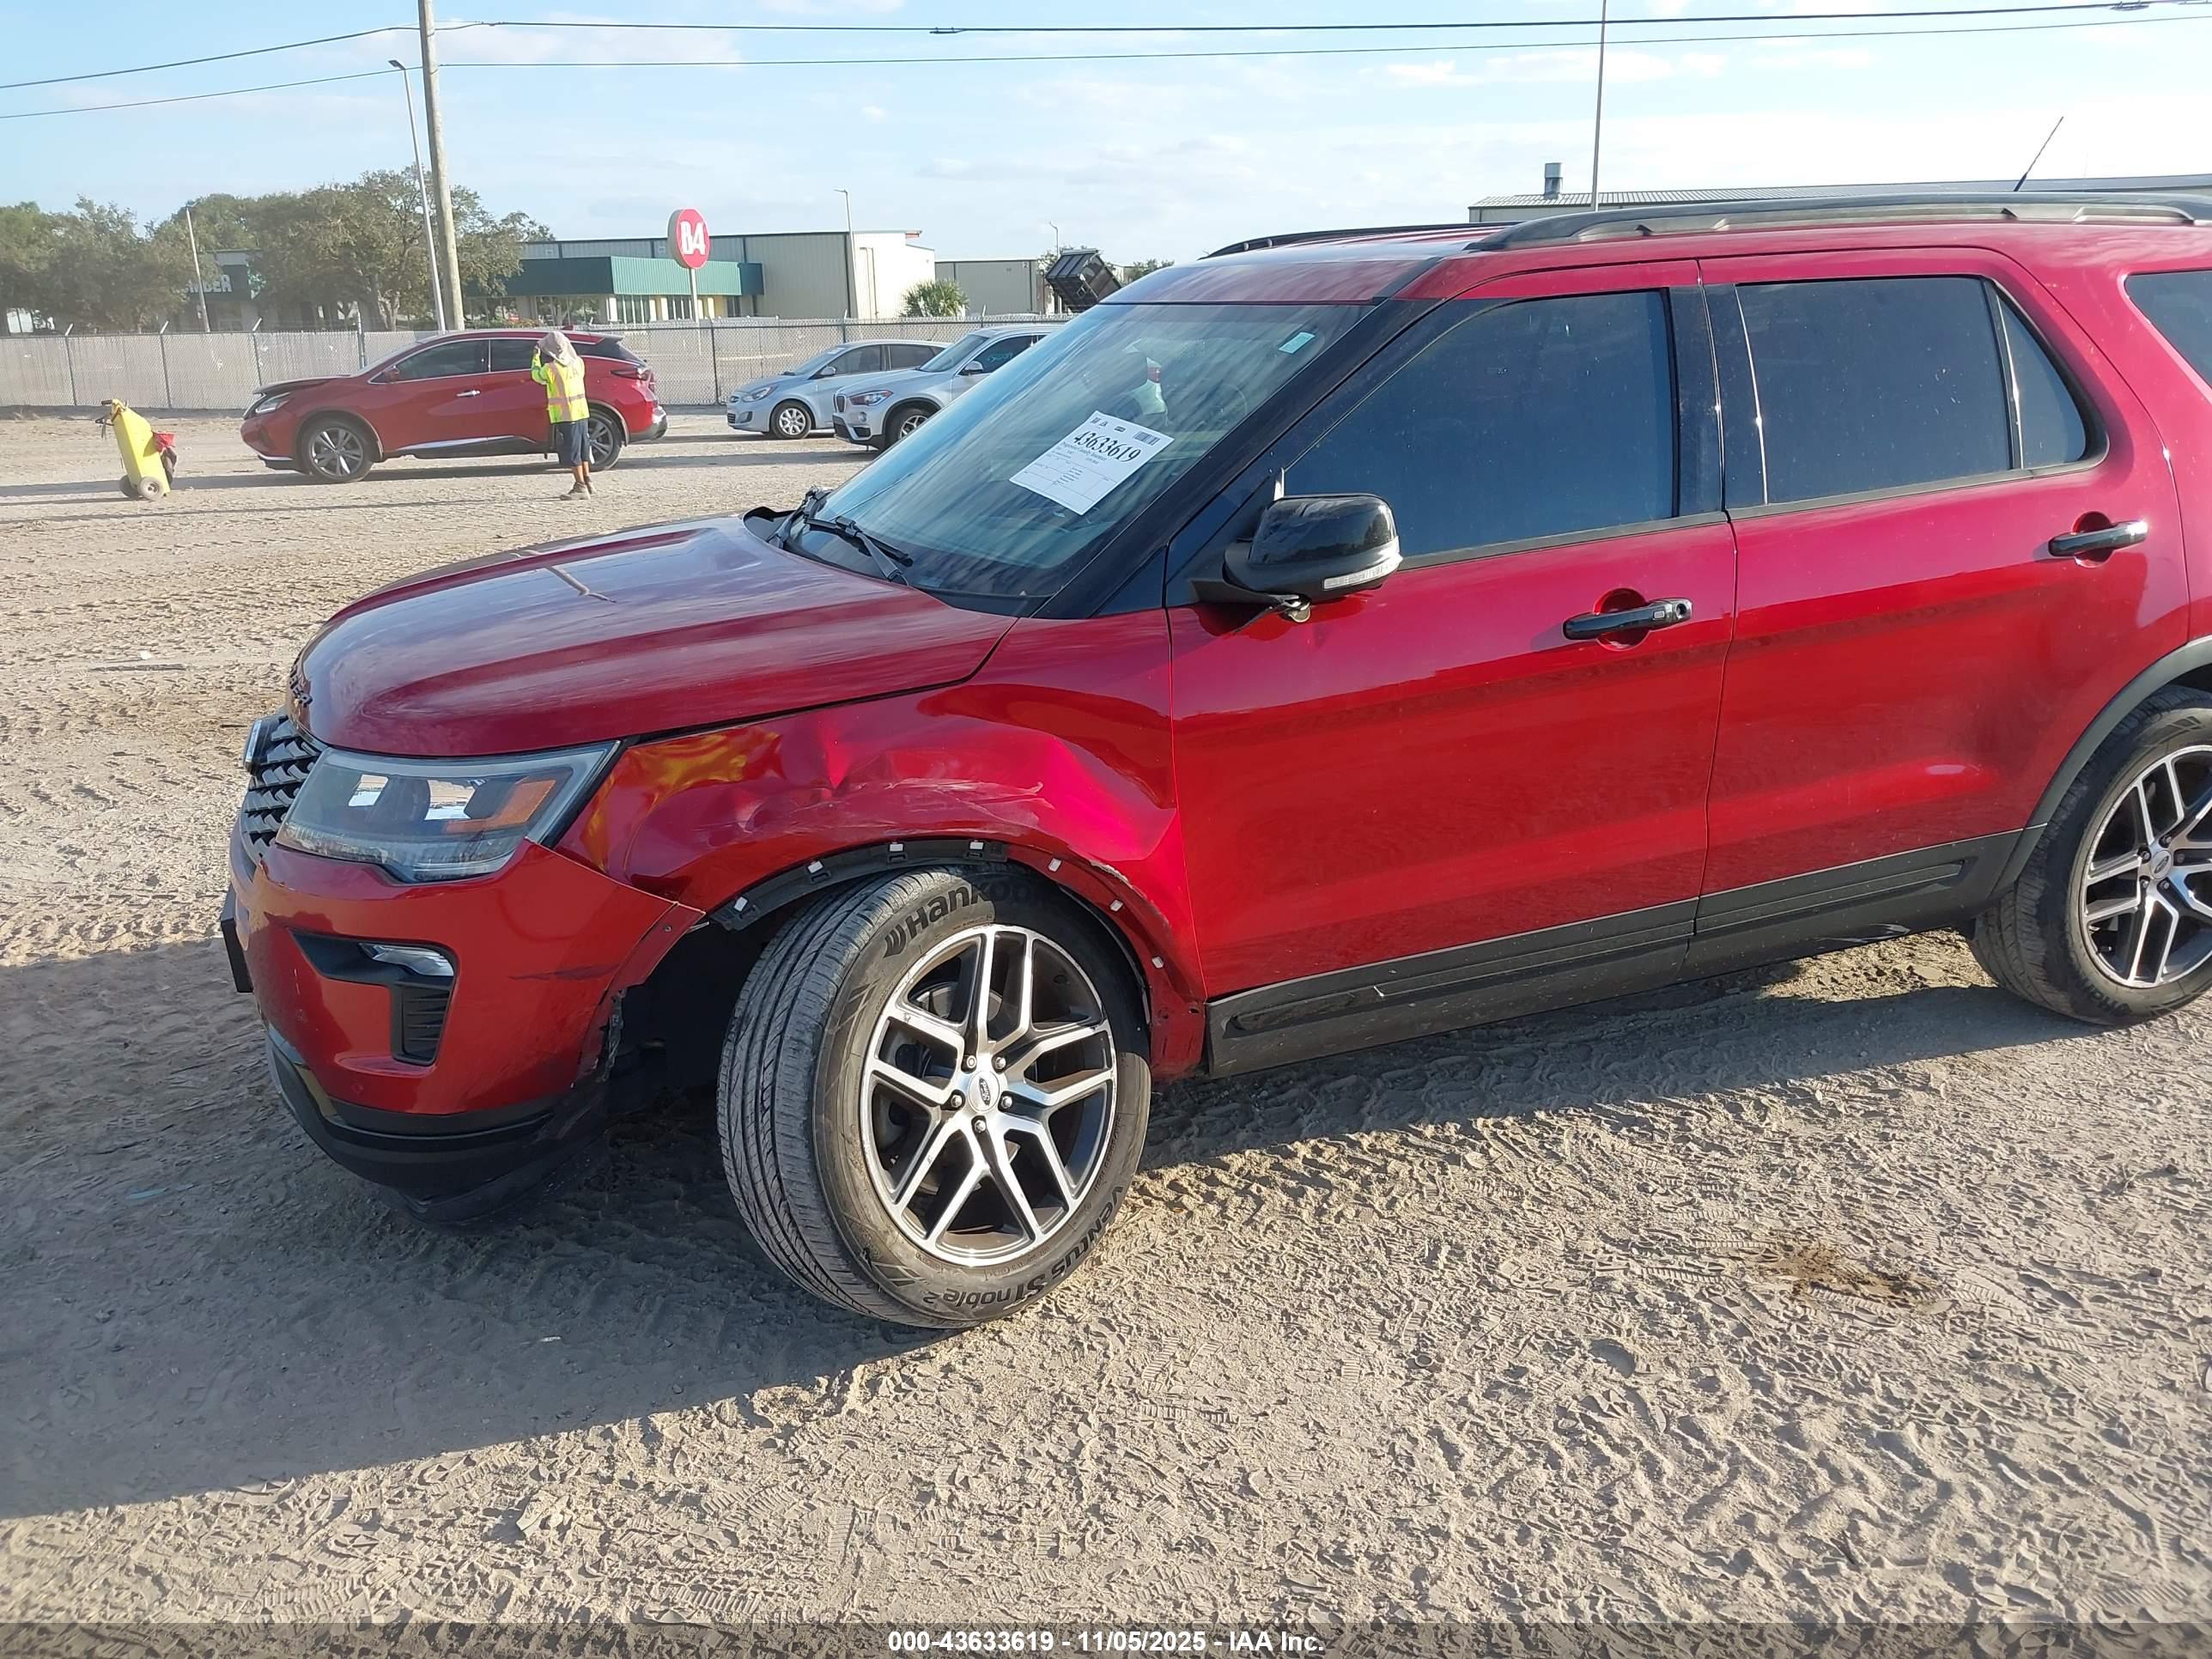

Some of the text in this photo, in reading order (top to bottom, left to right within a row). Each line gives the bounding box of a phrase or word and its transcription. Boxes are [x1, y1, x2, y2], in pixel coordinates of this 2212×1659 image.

[679, 220, 706, 256] 84
[1073, 429, 1142, 464] 43633619
[905, 878, 1036, 941] Hankoo
